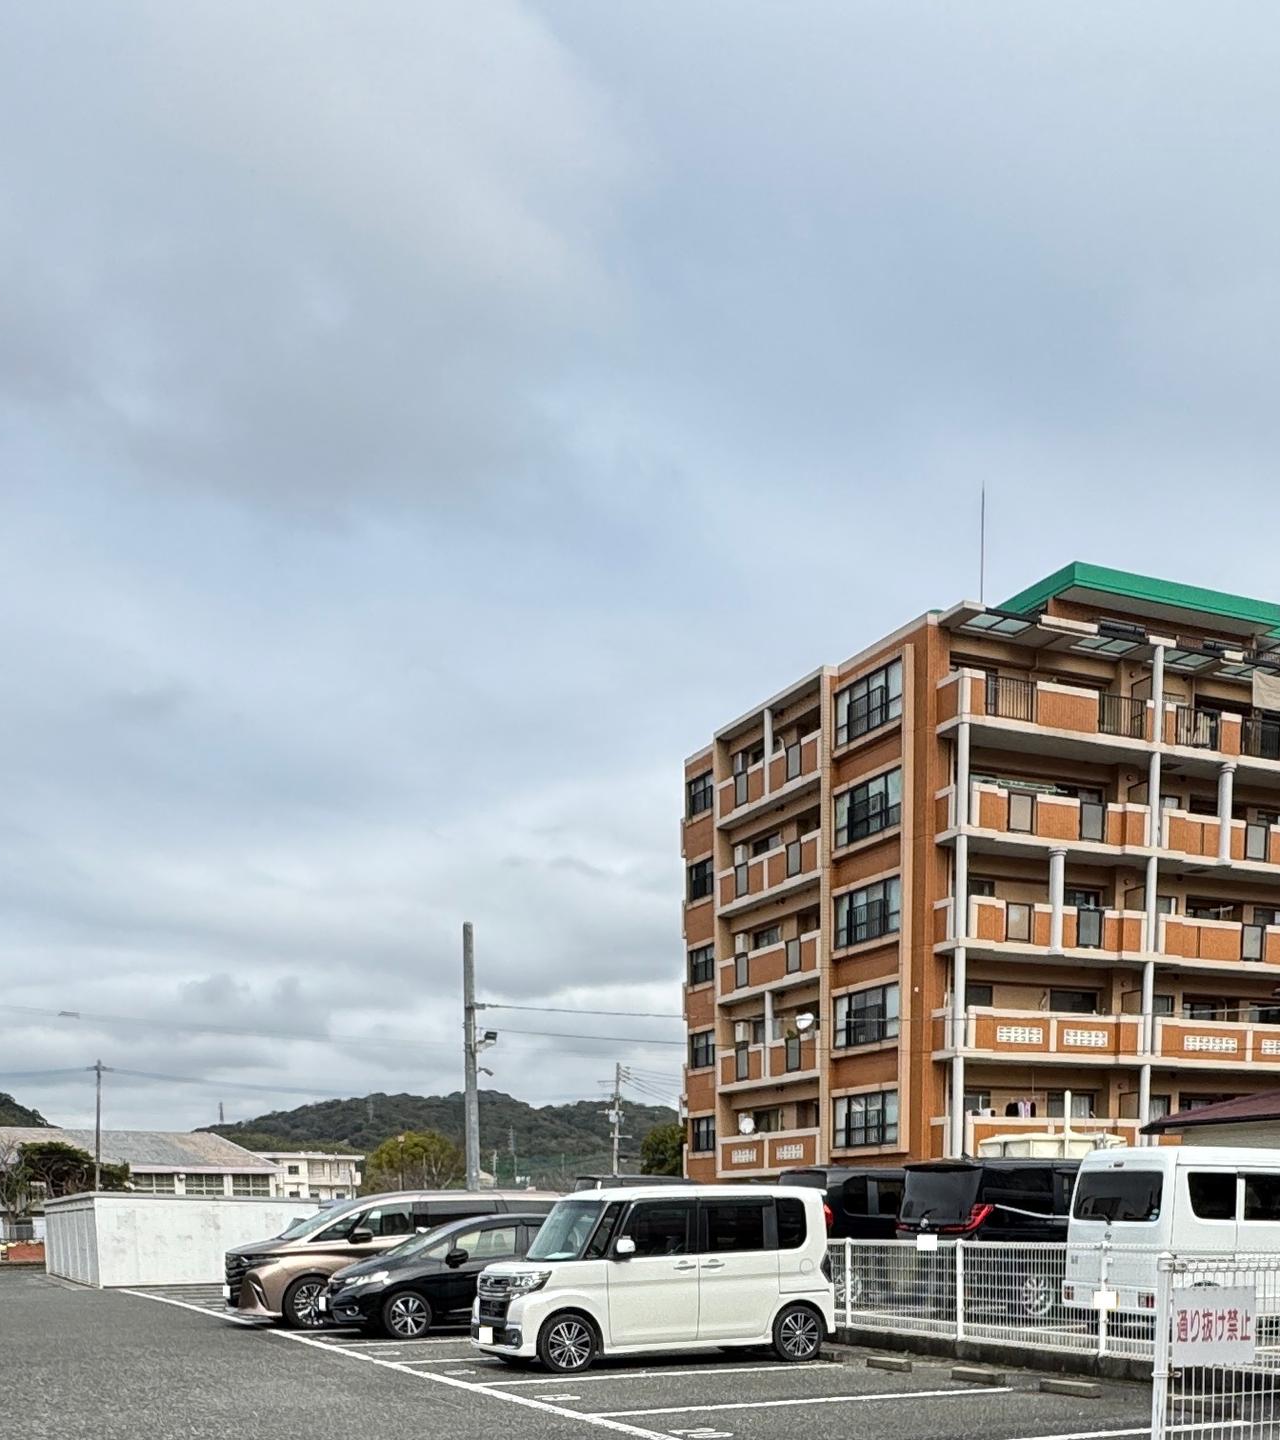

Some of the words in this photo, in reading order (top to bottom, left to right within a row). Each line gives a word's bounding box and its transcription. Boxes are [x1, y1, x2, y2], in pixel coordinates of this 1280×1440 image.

[1177, 1308, 1251, 1342] 通り抜け禁止
